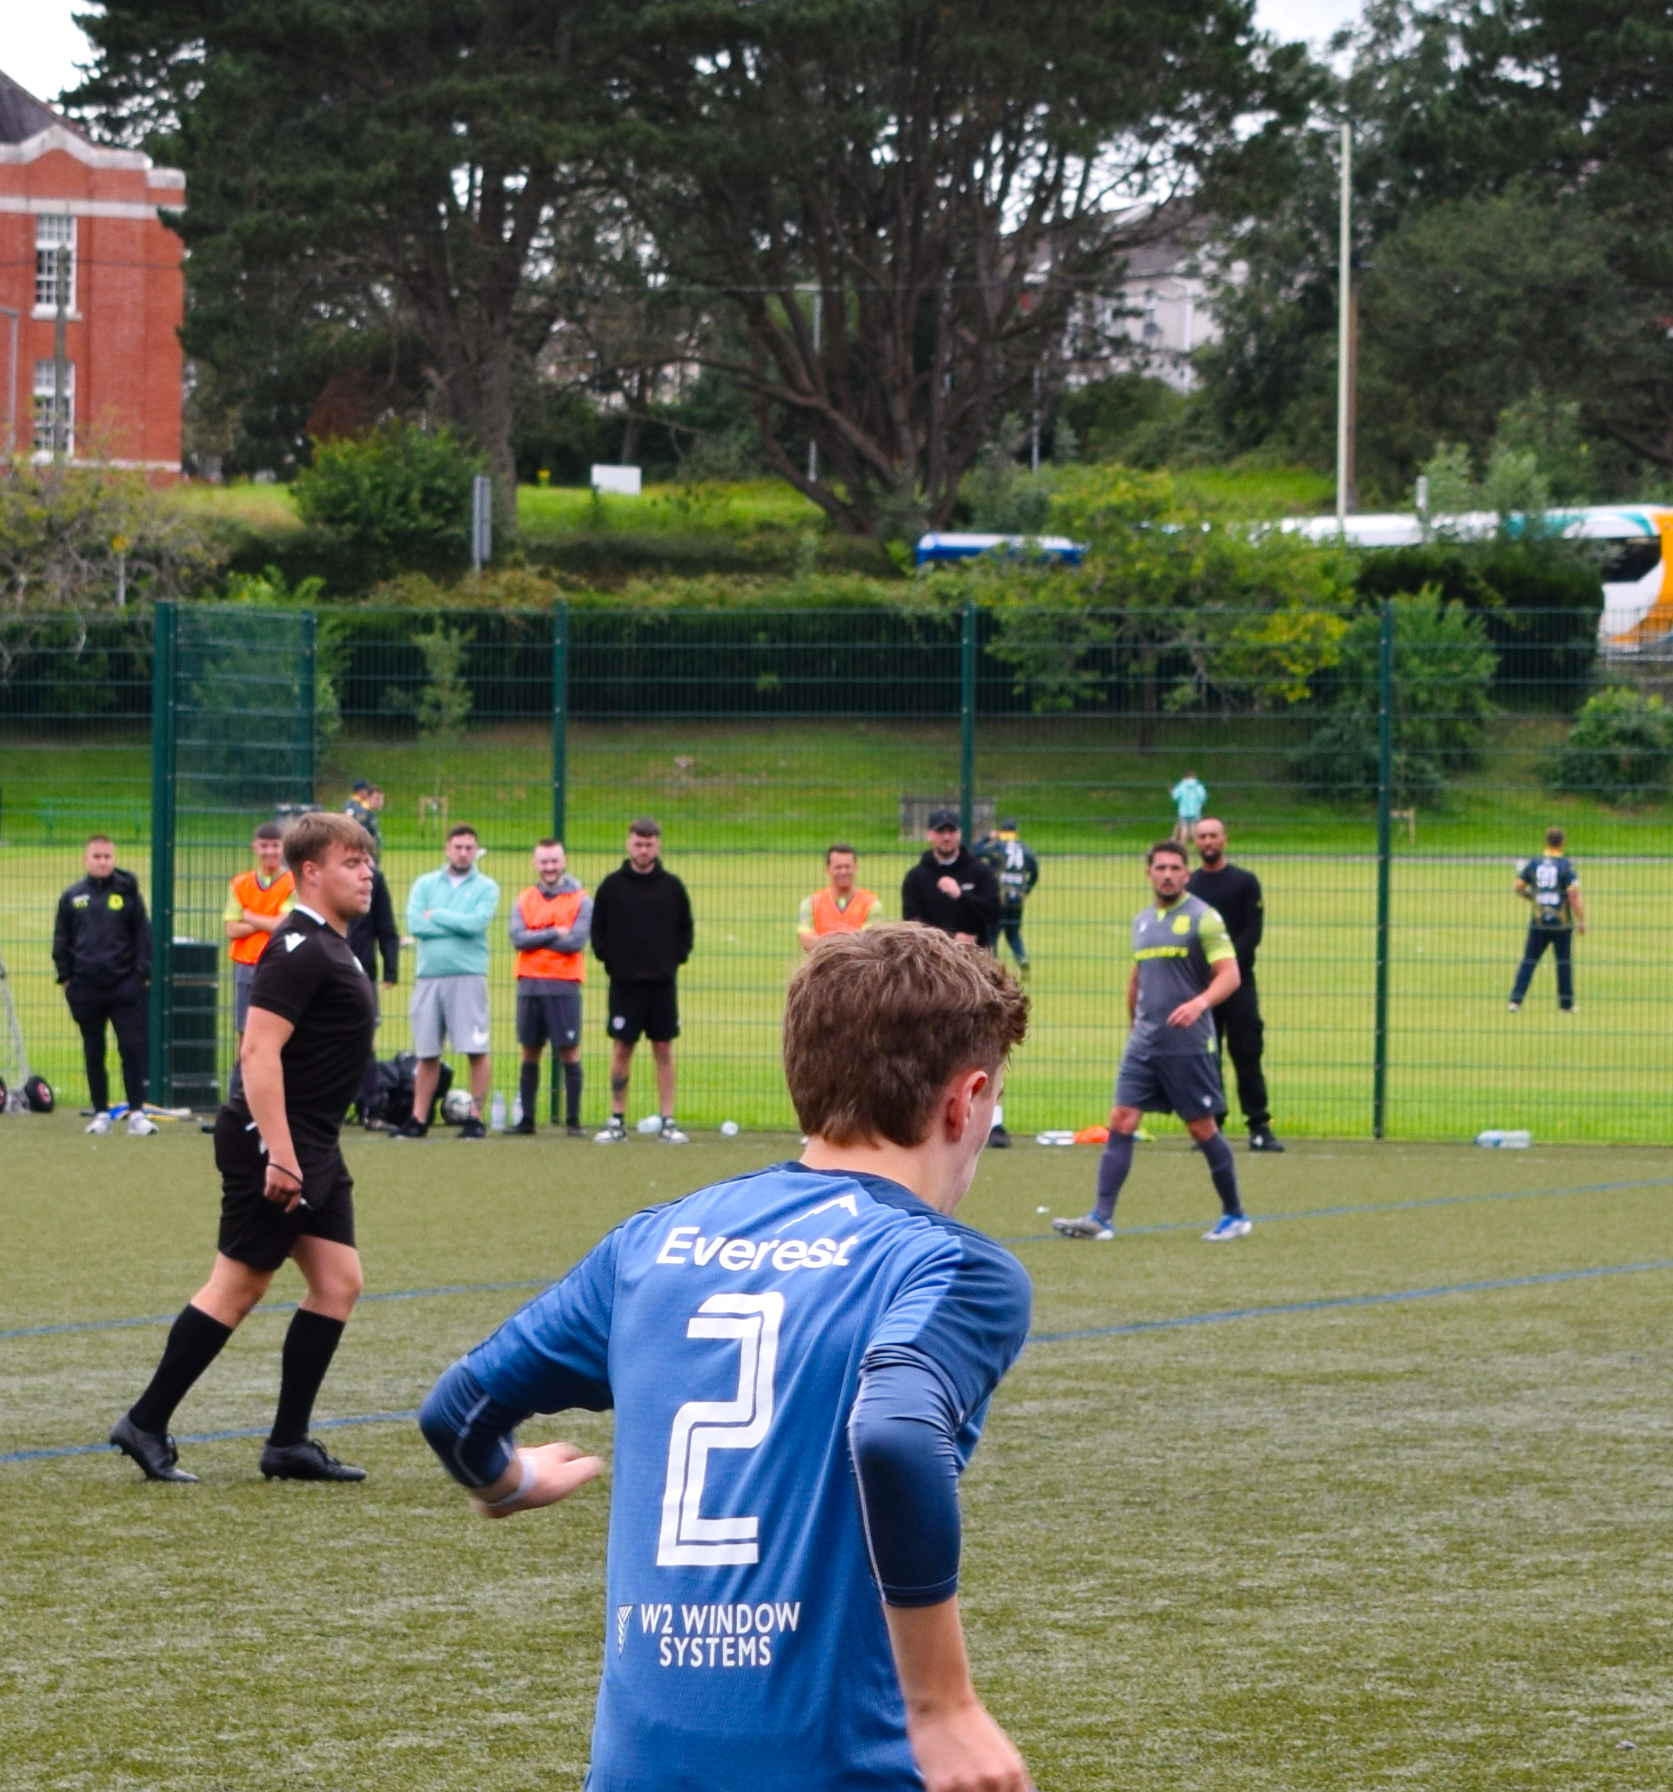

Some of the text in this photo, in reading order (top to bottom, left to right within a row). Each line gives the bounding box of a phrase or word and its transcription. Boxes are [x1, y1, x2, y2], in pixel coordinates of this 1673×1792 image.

[656, 1226, 859, 1272] Everest
[656, 1291, 784, 1566] 2
[641, 1602, 802, 1635] W2 WINDOW
[659, 1636, 772, 1668] SYSTEMS
